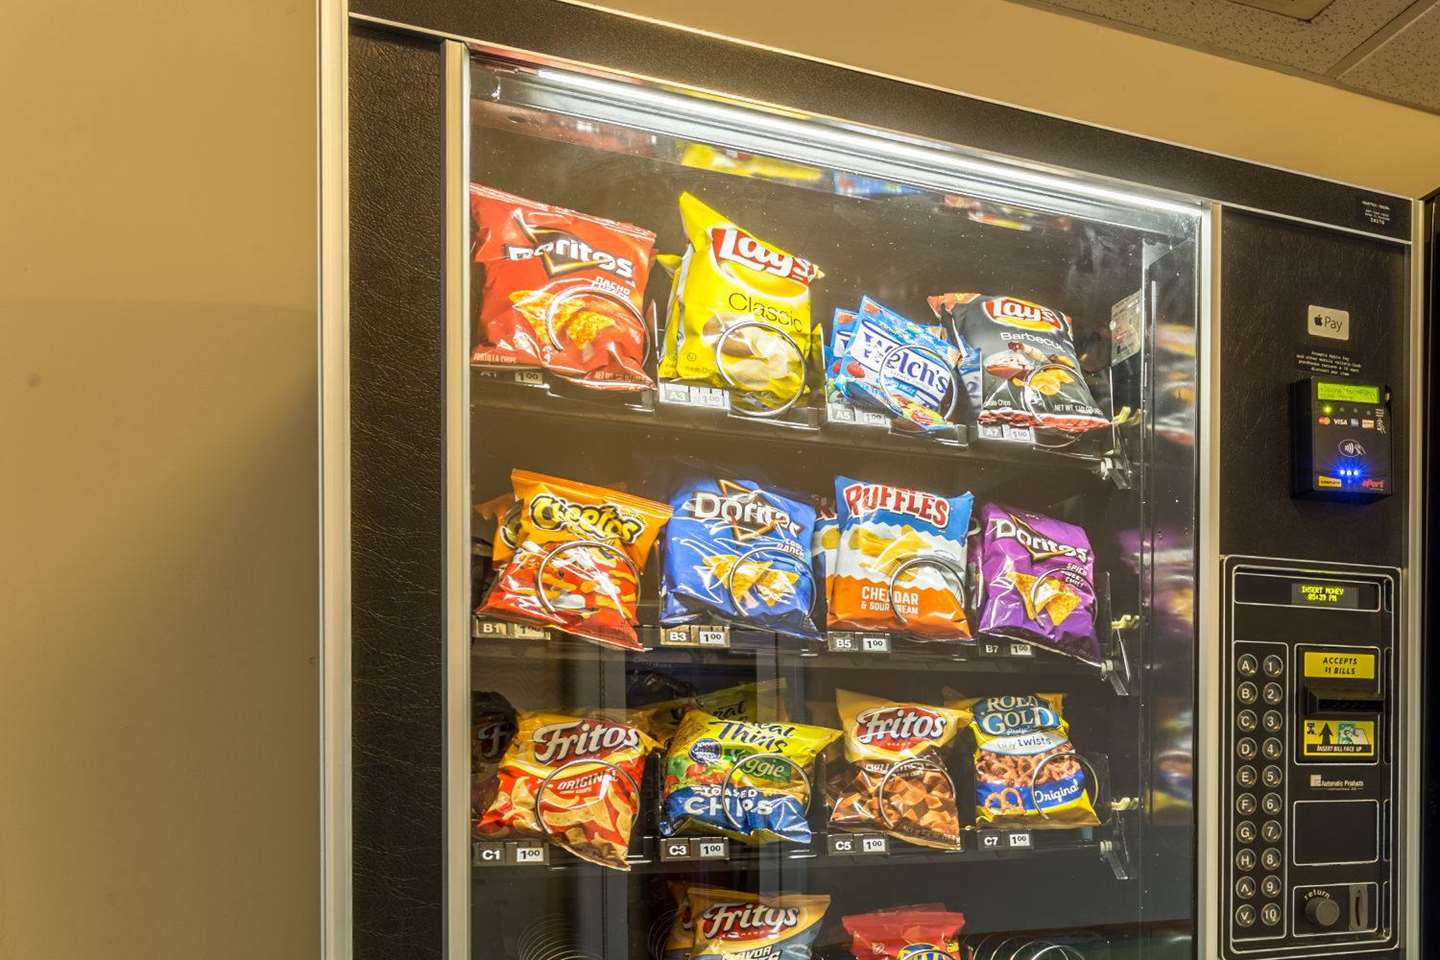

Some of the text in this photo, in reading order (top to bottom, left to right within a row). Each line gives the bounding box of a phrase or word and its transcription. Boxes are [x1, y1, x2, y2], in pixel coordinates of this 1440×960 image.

[508, 239, 634, 278] Doritos
[729, 293, 802, 332] Classic
[1324, 315, 1343, 332] Pay
[844, 484, 950, 528] RUFFLES
[530, 494, 645, 544] Cheetos
[694, 492, 801, 537] Doritos
[996, 519, 1089, 562] Doritos
[862, 586, 919, 606] CHEDAR
[1325, 587, 1344, 595] MONEY
[870, 601, 890, 612] SOUR
[482, 623, 500, 634] B1
[669, 633, 687, 642] B3
[836, 639, 852, 648] B5
[1241, 660, 1250, 671] A
[1323, 657, 1358, 665] ACCEPTS
[1334, 667, 1356, 675] BILLS
[1241, 688, 1250, 699] B
[856, 706, 947, 744] Fritos
[982, 707, 1055, 735] GOLD
[1241, 716, 1250, 727] C
[533, 719, 641, 762] Fritos
[1018, 735, 1052, 747] twists
[1241, 743, 1250, 754] D
[1241, 771, 1249, 782] E
[1034, 778, 1080, 803] Original
[684, 796, 775, 817] CHIPS
[1241, 799, 1249, 810] F
[1240, 827, 1250, 838] G
[835, 841, 852, 851] C5
[984, 836, 999, 846] C7
[482, 850, 500, 860] C1
[669, 846, 687, 855] C3
[1241, 855, 1250, 866] H
[1304, 888, 1331, 900] return
[1265, 909, 1277, 921] 10
